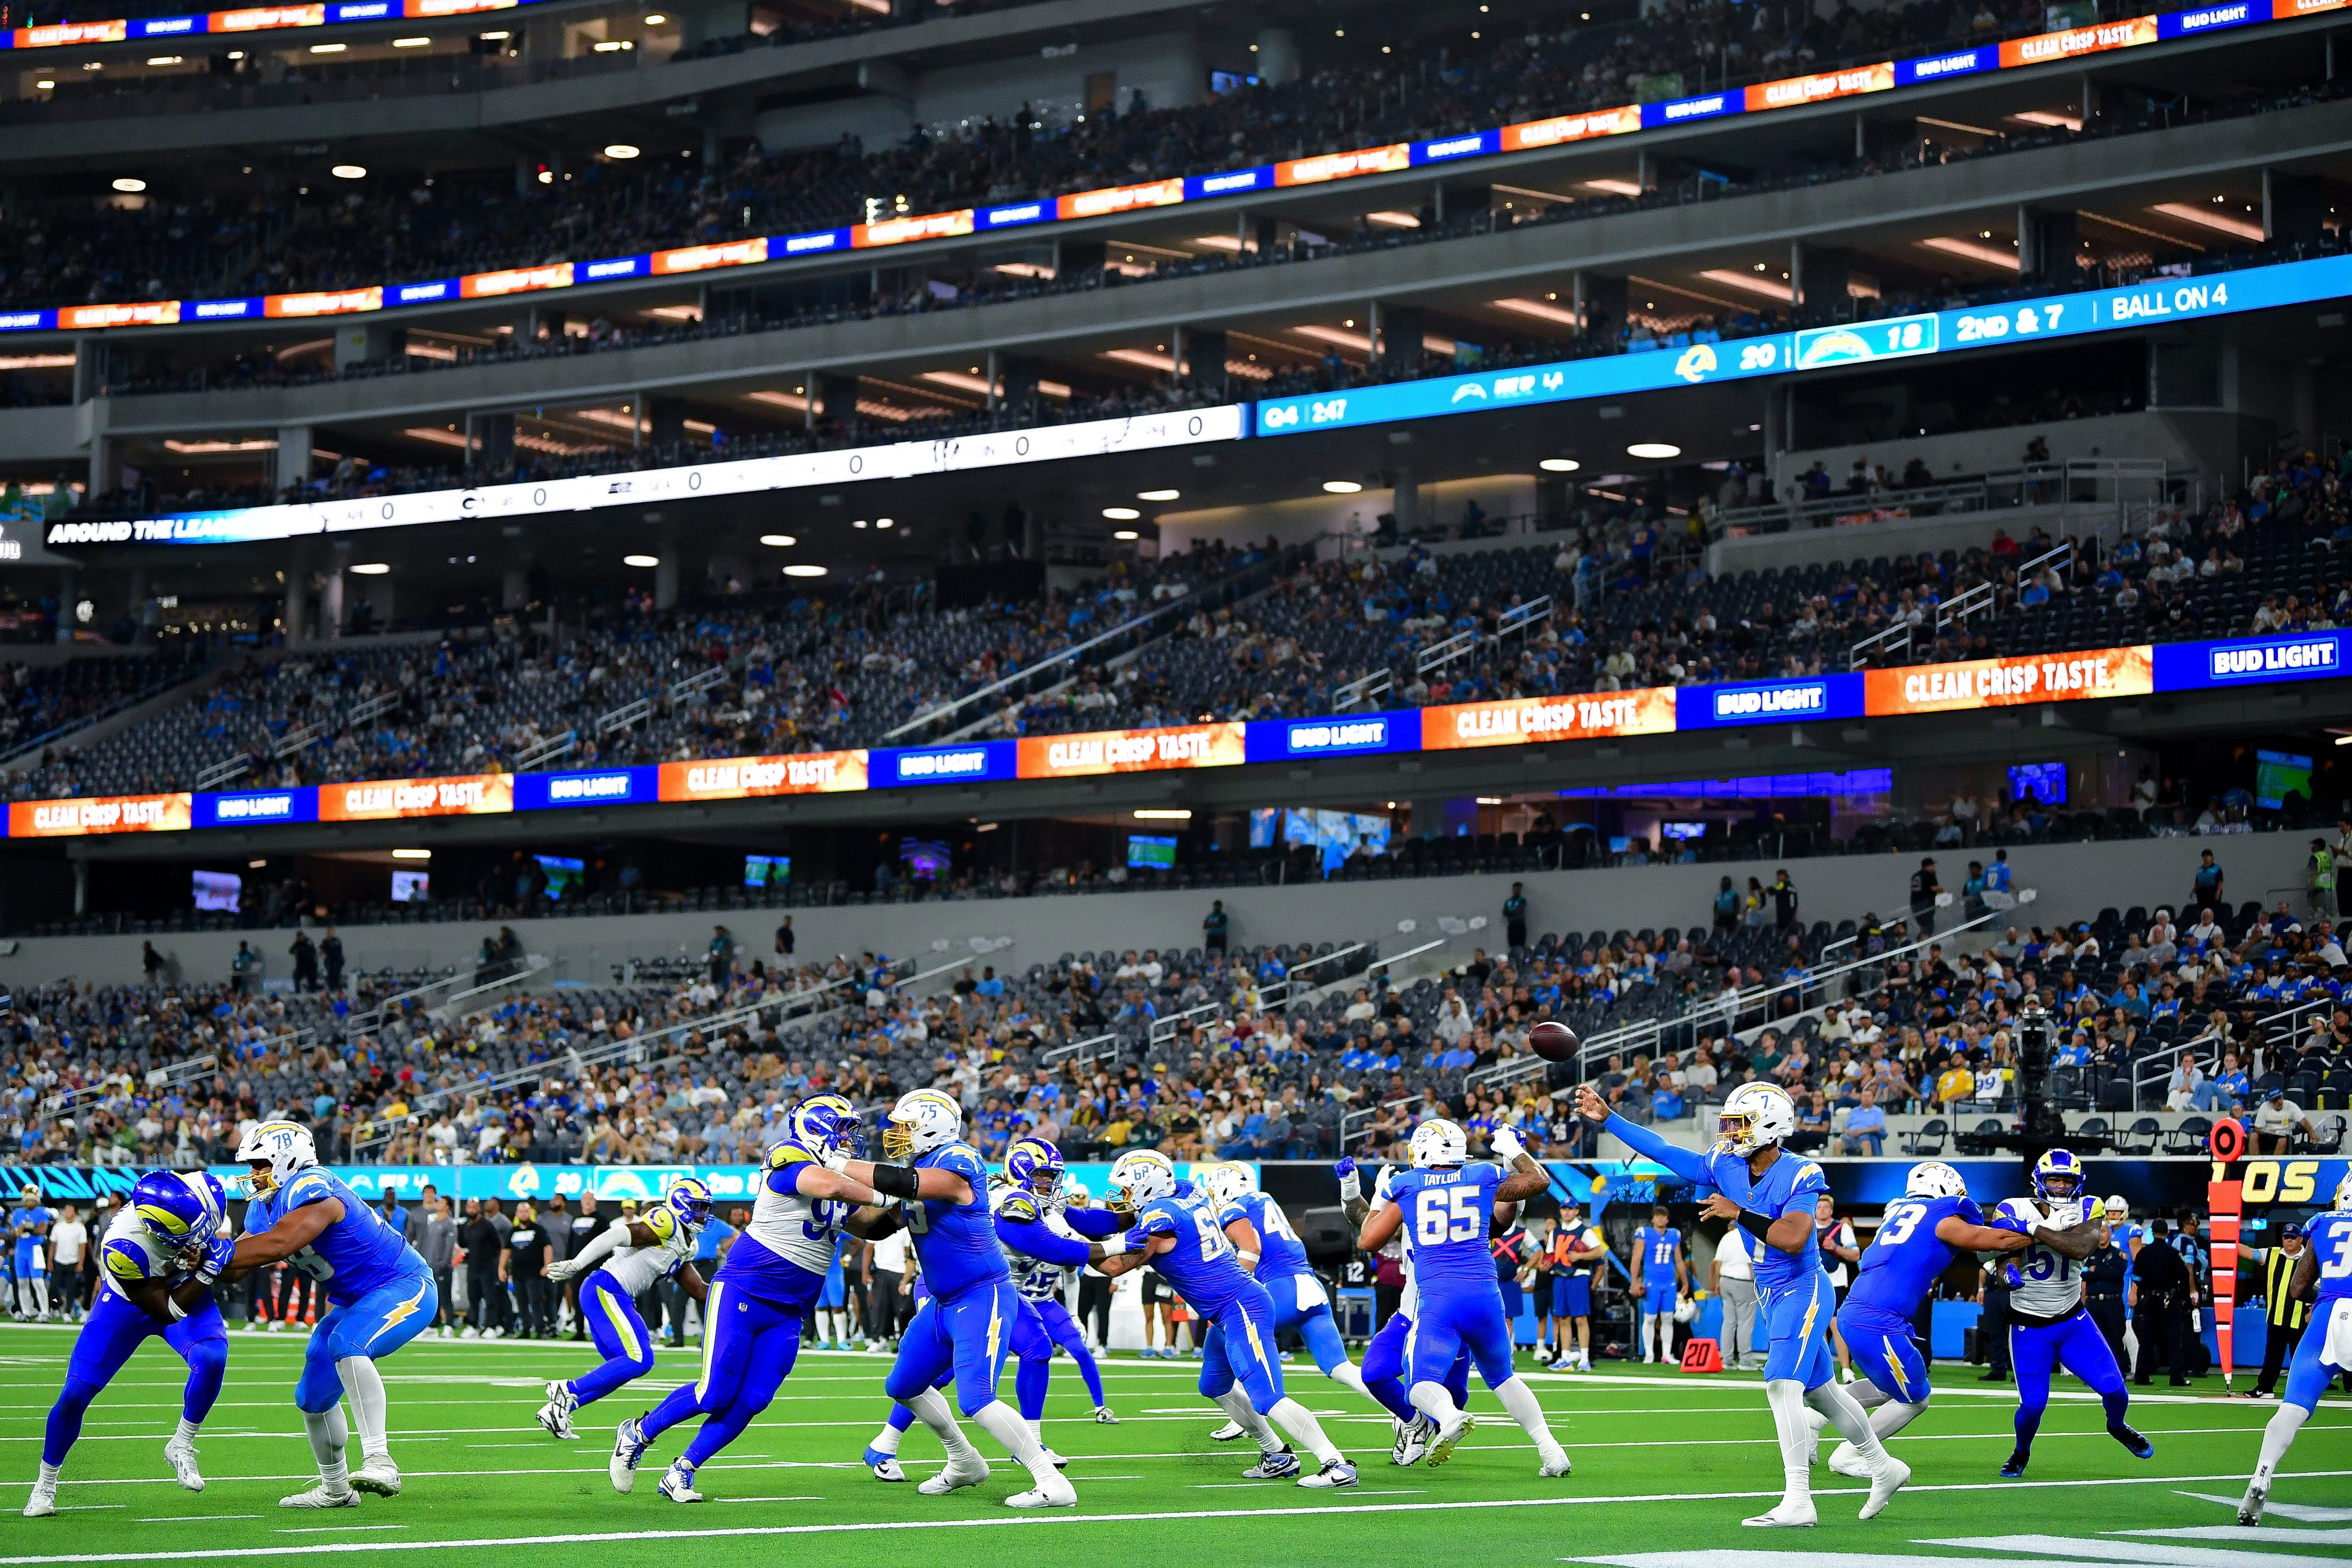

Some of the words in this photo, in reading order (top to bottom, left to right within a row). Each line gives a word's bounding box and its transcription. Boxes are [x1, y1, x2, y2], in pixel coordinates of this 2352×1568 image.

[2183, 14, 2208, 28] BUD
[2210, 6, 2246, 23] LIGHT
[2022, 38, 2059, 58] CLEAN
[2061, 32, 2095, 51] CRISP
[2097, 25, 2133, 45] TASTE
[2113, 292, 2171, 320] BALL
[2175, 286, 2208, 312] ON
[2212, 284, 2228, 305] 4
[1957, 316, 2008, 341] 2ND
[2016, 308, 2038, 333] &
[2044, 304, 2064, 329] 7
[1888, 324, 1921, 350] 18
[1740, 343, 1776, 370] 20
[47, 522, 132, 543] AROUND
[134, 520, 175, 540] THE
[2215, 650, 2263, 673] BUD
[2266, 643, 2333, 669] LIGHT
[1906, 671, 1972, 702] CLEAN
[1977, 665, 2037, 696] CRISP
[2043, 659, 2109, 691] TASTE
[1718, 693, 1760, 714] BUD
[1762, 688, 1821, 711] LIGHT
[1457, 708, 1516, 738] CLEAN
[1520, 704, 1575, 732] CRISP
[1578, 698, 1637, 728] TASTE
[1292, 728, 1330, 747] BUD
[1331, 723, 1383, 745] LIGHT
[1049, 740, 1103, 768] CLEAN
[1105, 737, 1155, 763] CRISP
[1158, 732, 1210, 760] TASTE
[688, 766, 738, 791] CLEAN
[740, 763, 785, 788] CRISP
[788, 759, 836, 786] TASTE
[346, 788, 392, 812] CLEAN
[394, 785, 437, 809] CRISP
[439, 782, 485, 807] TASTE
[920, 1104, 937, 1119] 75
[1761, 1095, 1769, 1109] 7
[273, 1133, 292, 1150] 78
[555, 1173, 581, 1194] 20
[707, 1173, 743, 1194] 2ND
[1424, 1170, 1461, 1186] TAYLOR
[1942, 1168, 1955, 1179] 73
[1416, 1185, 1480, 1246] 65
[1553, 1233, 1576, 1267] K
[1655, 1243, 1672, 1264] 11
[1346, 1261, 1365, 1283] 12
[1686, 1343, 1710, 1367] 20
